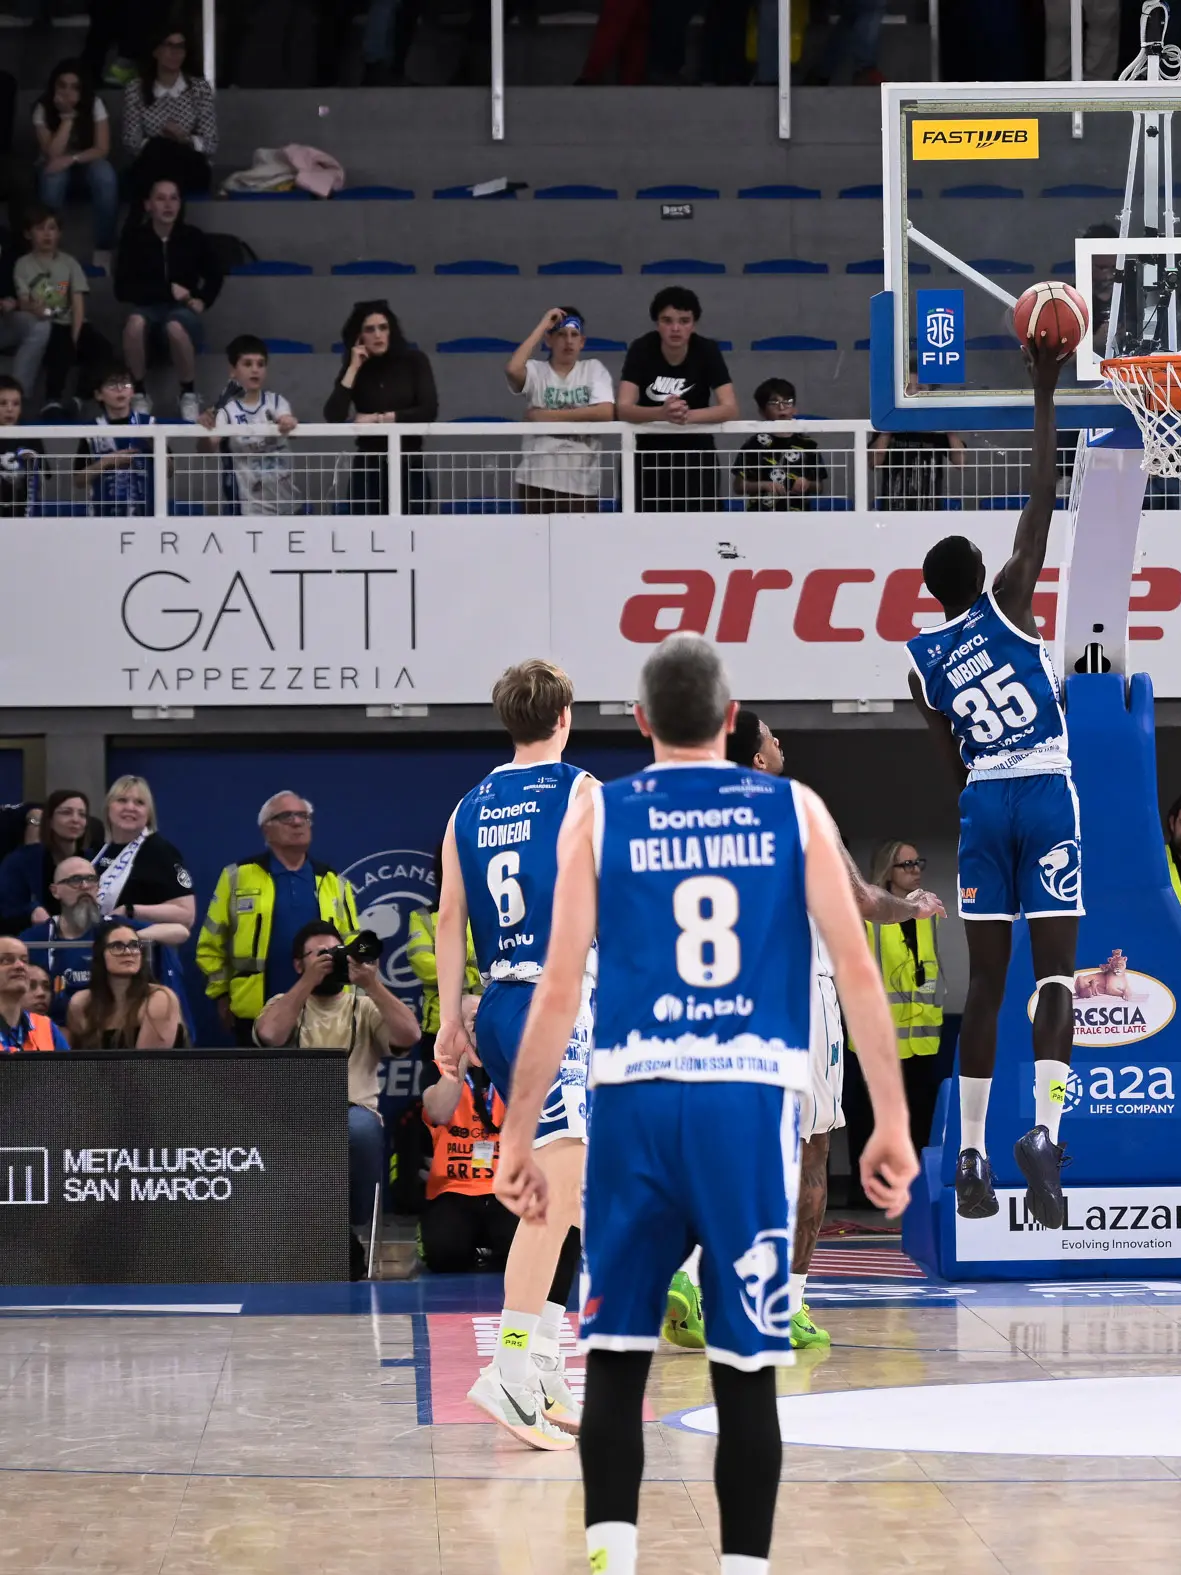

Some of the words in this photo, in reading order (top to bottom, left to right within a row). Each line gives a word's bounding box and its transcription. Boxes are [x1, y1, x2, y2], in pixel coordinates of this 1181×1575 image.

[922, 130, 1028, 148] FASTWEB
[922, 352, 960, 366] FIP
[652, 376, 687, 394] NIKE
[120, 530, 416, 554] FRATELLI
[121, 568, 417, 652] GATTI
[121, 667, 416, 691] TAPPEZZERIA
[946, 649, 994, 690] MBOW
[952, 663, 1038, 743] 35
[479, 800, 541, 820] bonera.
[648, 806, 761, 831] bonera.
[477, 820, 531, 848] DONEDA
[629, 836, 704, 873] DELLA
[704, 831, 776, 868] VALLE
[351, 864, 437, 895] LACANE
[487, 850, 526, 928] 6
[673, 875, 741, 988] 8
[1072, 1005, 1147, 1027] RESCIA
[1073, 1025, 1102, 1035] TRALE
[1104, 1026, 1120, 1034] DEL
[1123, 1025, 1147, 1034] LATTE
[624, 1060, 672, 1077] BRESCIA
[673, 1056, 734, 1072] LEONESSA
[736, 1056, 780, 1074] D'ITALIA
[1089, 1065, 1175, 1100] a2a
[1090, 1105, 1113, 1114] LIFE
[1115, 1104, 1174, 1114] COMPANY
[63, 1147, 266, 1173] METALLURGICA
[63, 1177, 120, 1202] SAN
[130, 1176, 232, 1201] MARCO
[1061, 1239, 1109, 1251] Evolving
[1112, 1238, 1172, 1249] Innovation
[503, 1339, 524, 1347] PRS
